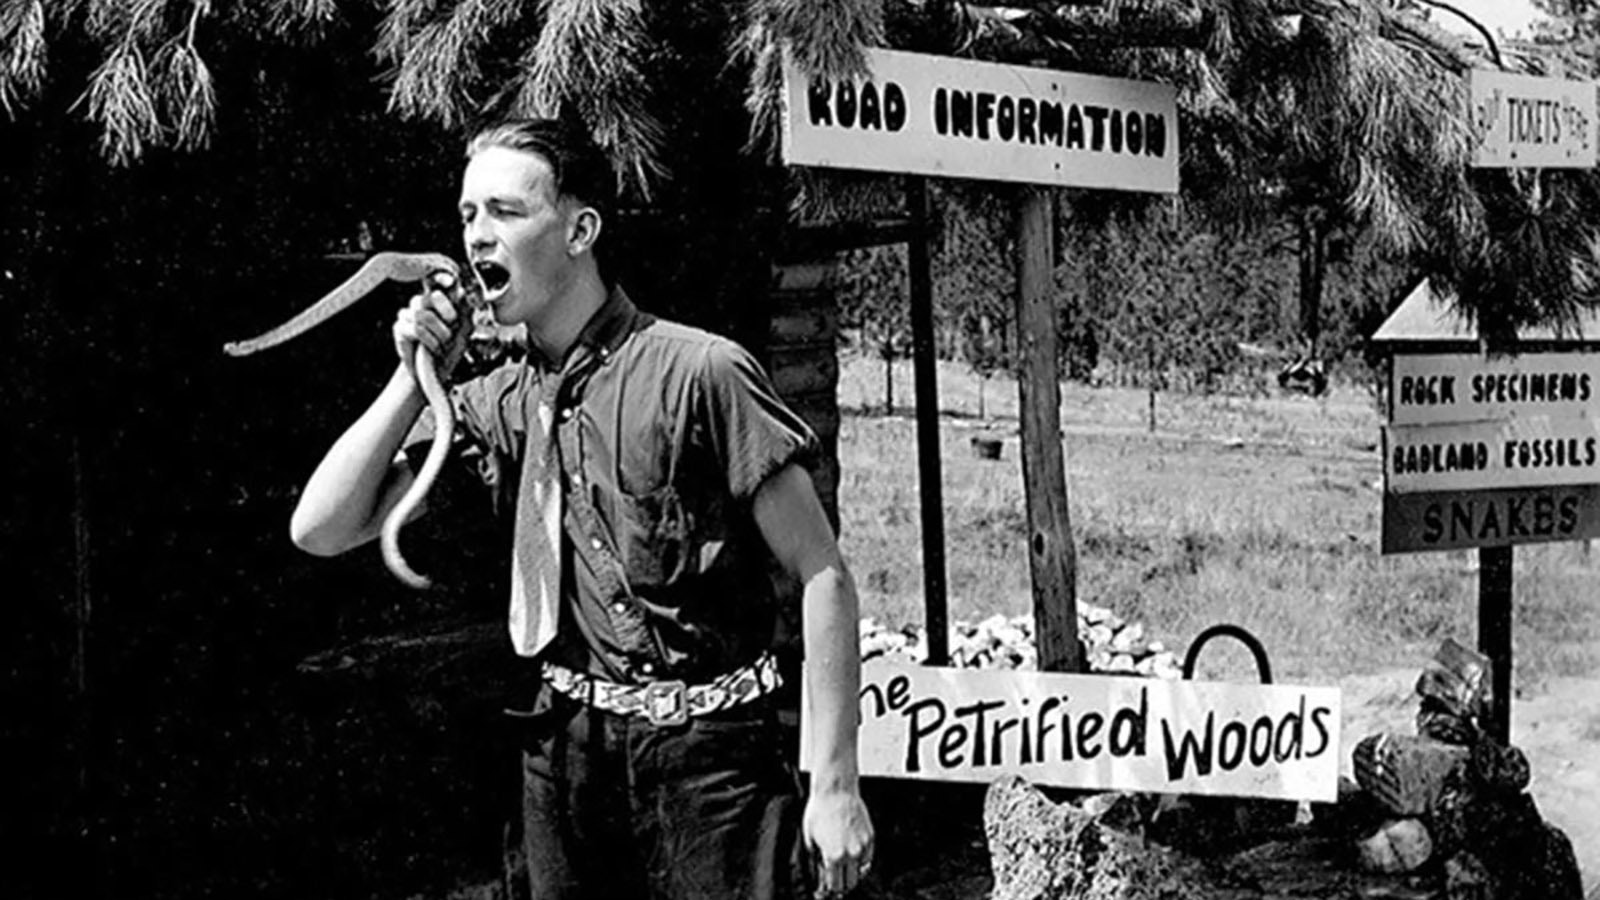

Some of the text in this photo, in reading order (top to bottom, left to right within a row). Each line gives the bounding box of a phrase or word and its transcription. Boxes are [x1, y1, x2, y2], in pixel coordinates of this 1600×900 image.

[807, 79, 1166, 157] ROAD INFORMATION
[1507, 98, 1560, 144] TICKETS
[1400, 372, 1591, 405] ROCK SPECIMENS
[1393, 437, 1596, 474] BADLAND FOSSILS
[1422, 495, 1580, 543] SNAKES
[859, 674, 911, 718] he
[1161, 694, 1331, 782] Woods
